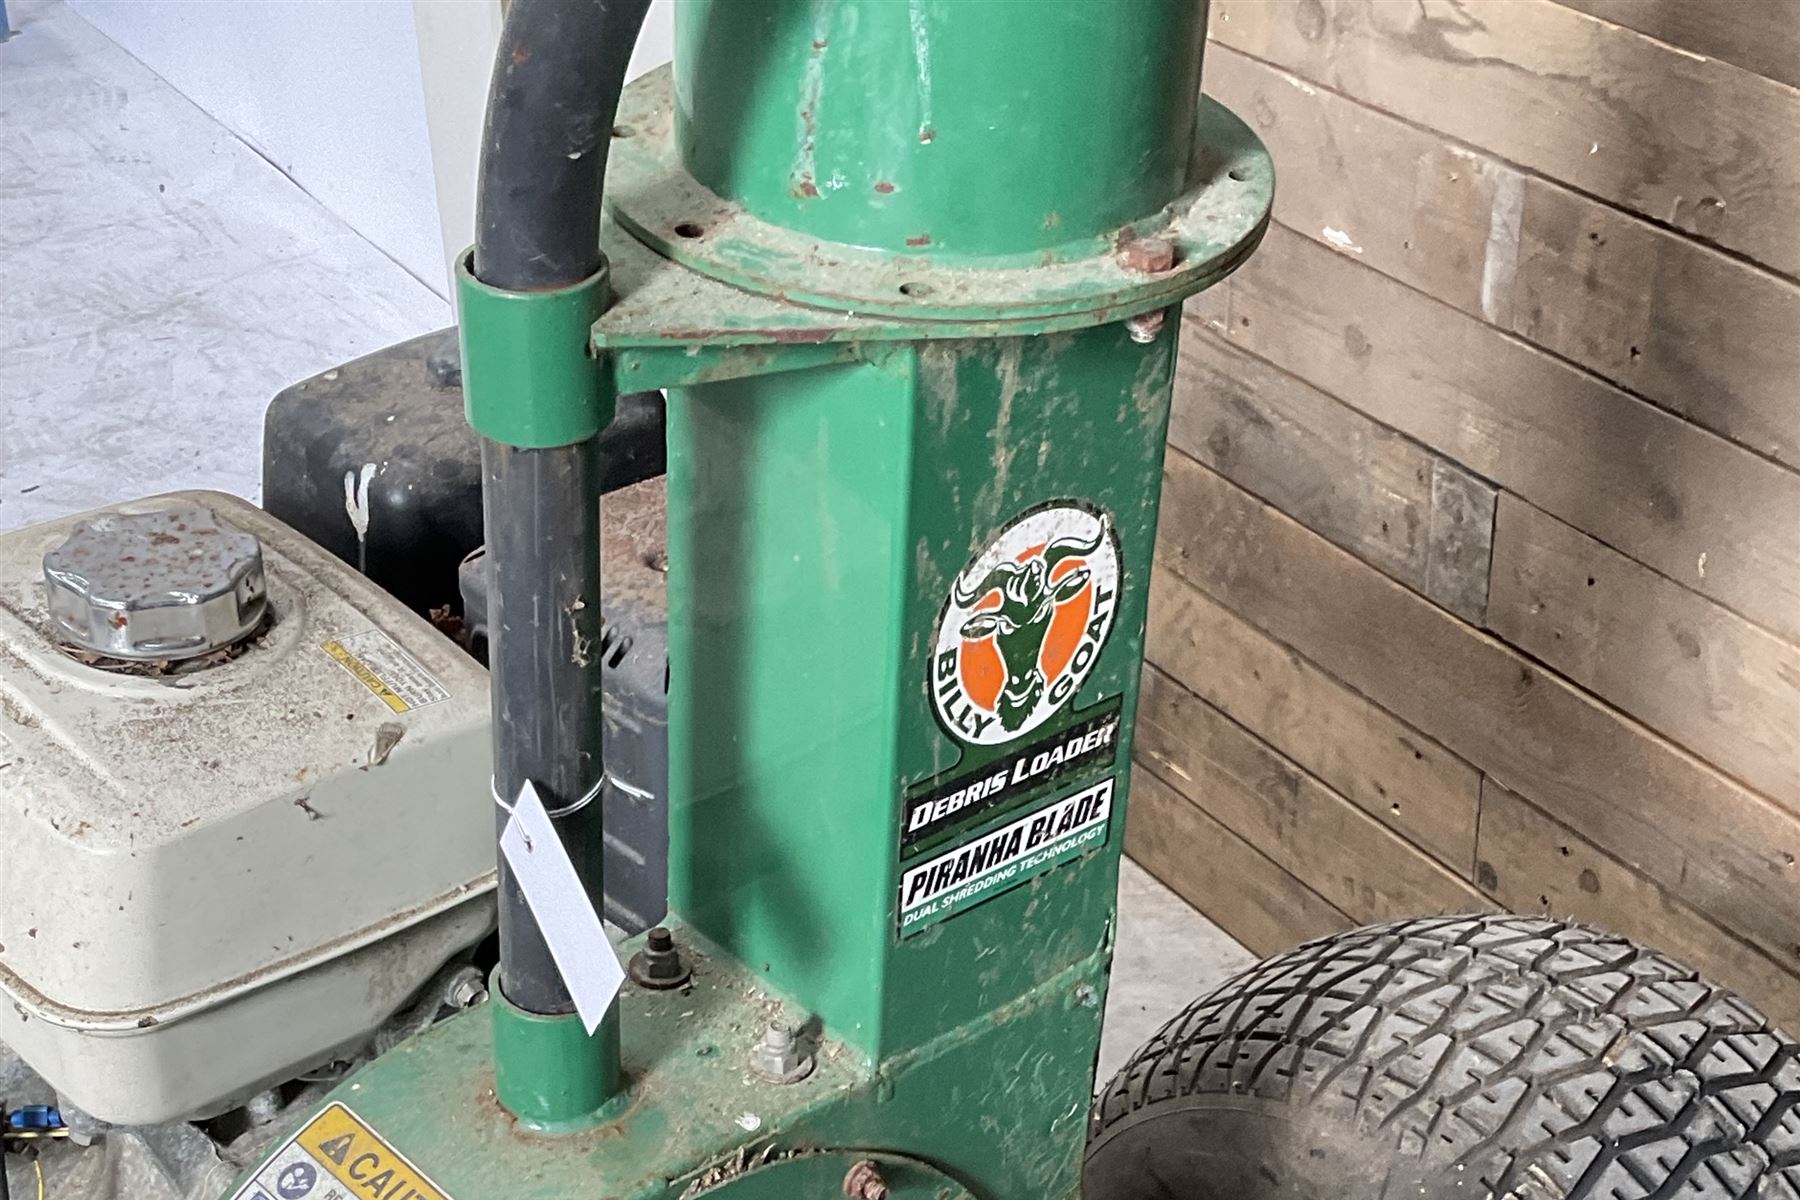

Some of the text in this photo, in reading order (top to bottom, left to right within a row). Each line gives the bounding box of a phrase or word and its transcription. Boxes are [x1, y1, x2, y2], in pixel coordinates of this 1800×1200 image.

[340, 655, 381, 688] CAUTION
[938, 586, 1112, 738] BILLY GOAT
[908, 722, 1118, 833] DEBRIS LOADER
[903, 824, 1105, 927] DUAL SHREDDING TECHNOLOGY
[905, 786, 1108, 906] PIRANHA BLADE
